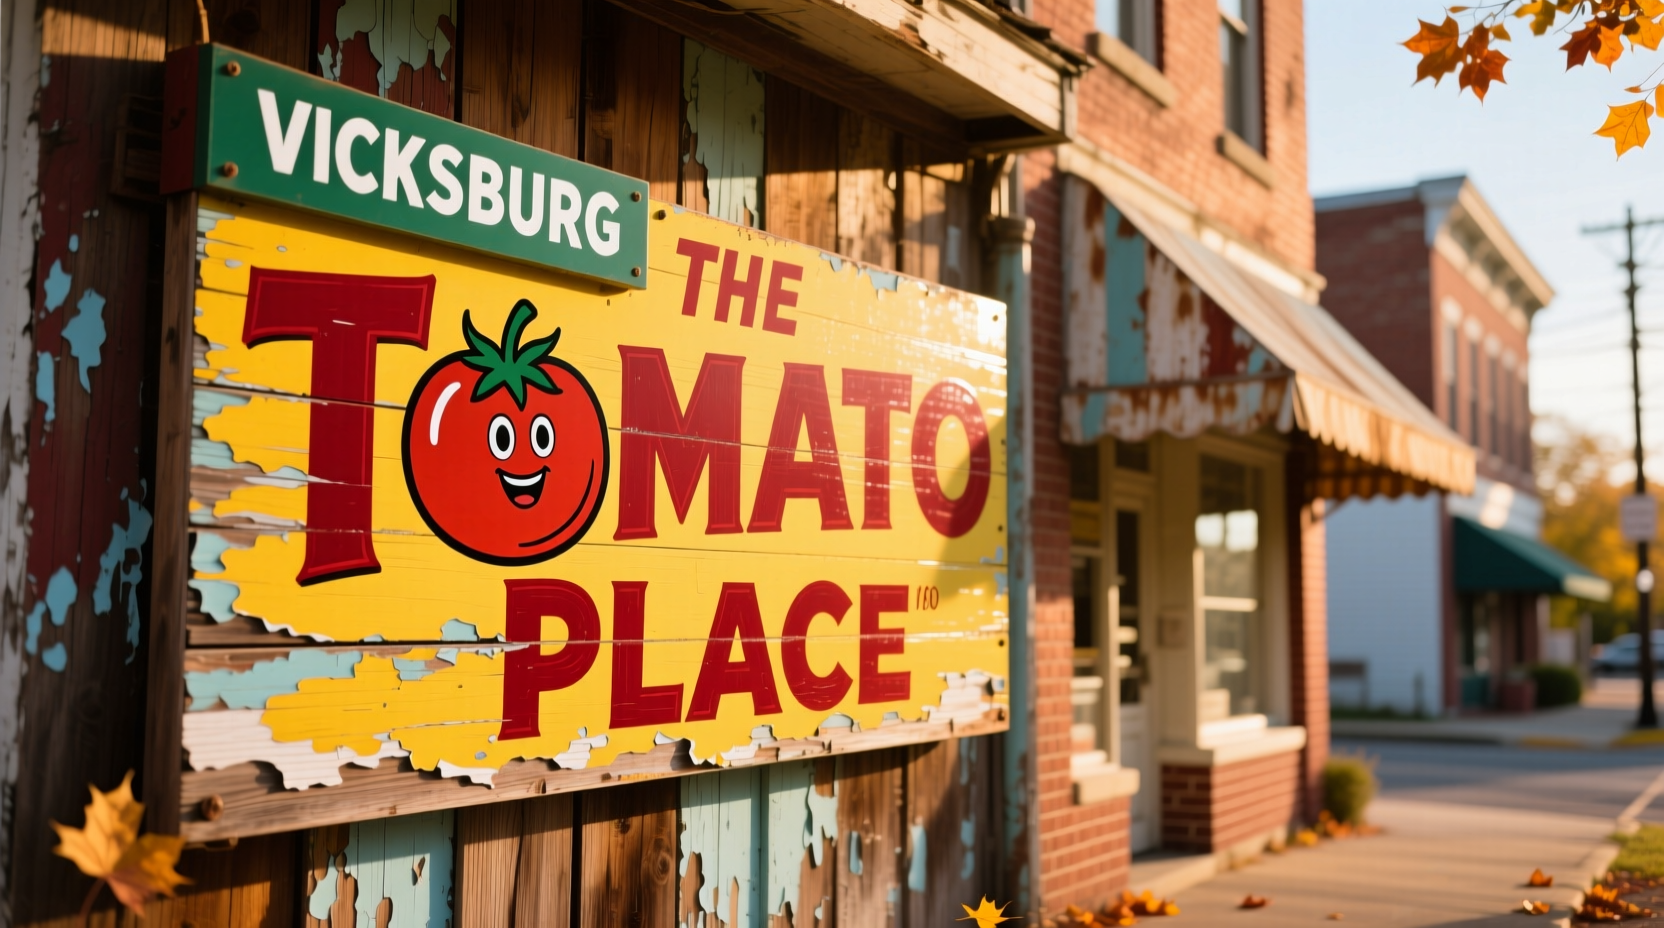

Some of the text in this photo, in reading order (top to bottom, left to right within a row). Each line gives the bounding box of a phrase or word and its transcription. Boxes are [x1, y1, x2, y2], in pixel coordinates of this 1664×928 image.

[258, 89, 621, 257] VICKSBURG
[676, 238, 803, 336] THE
[497, 578, 912, 741] PLACE
